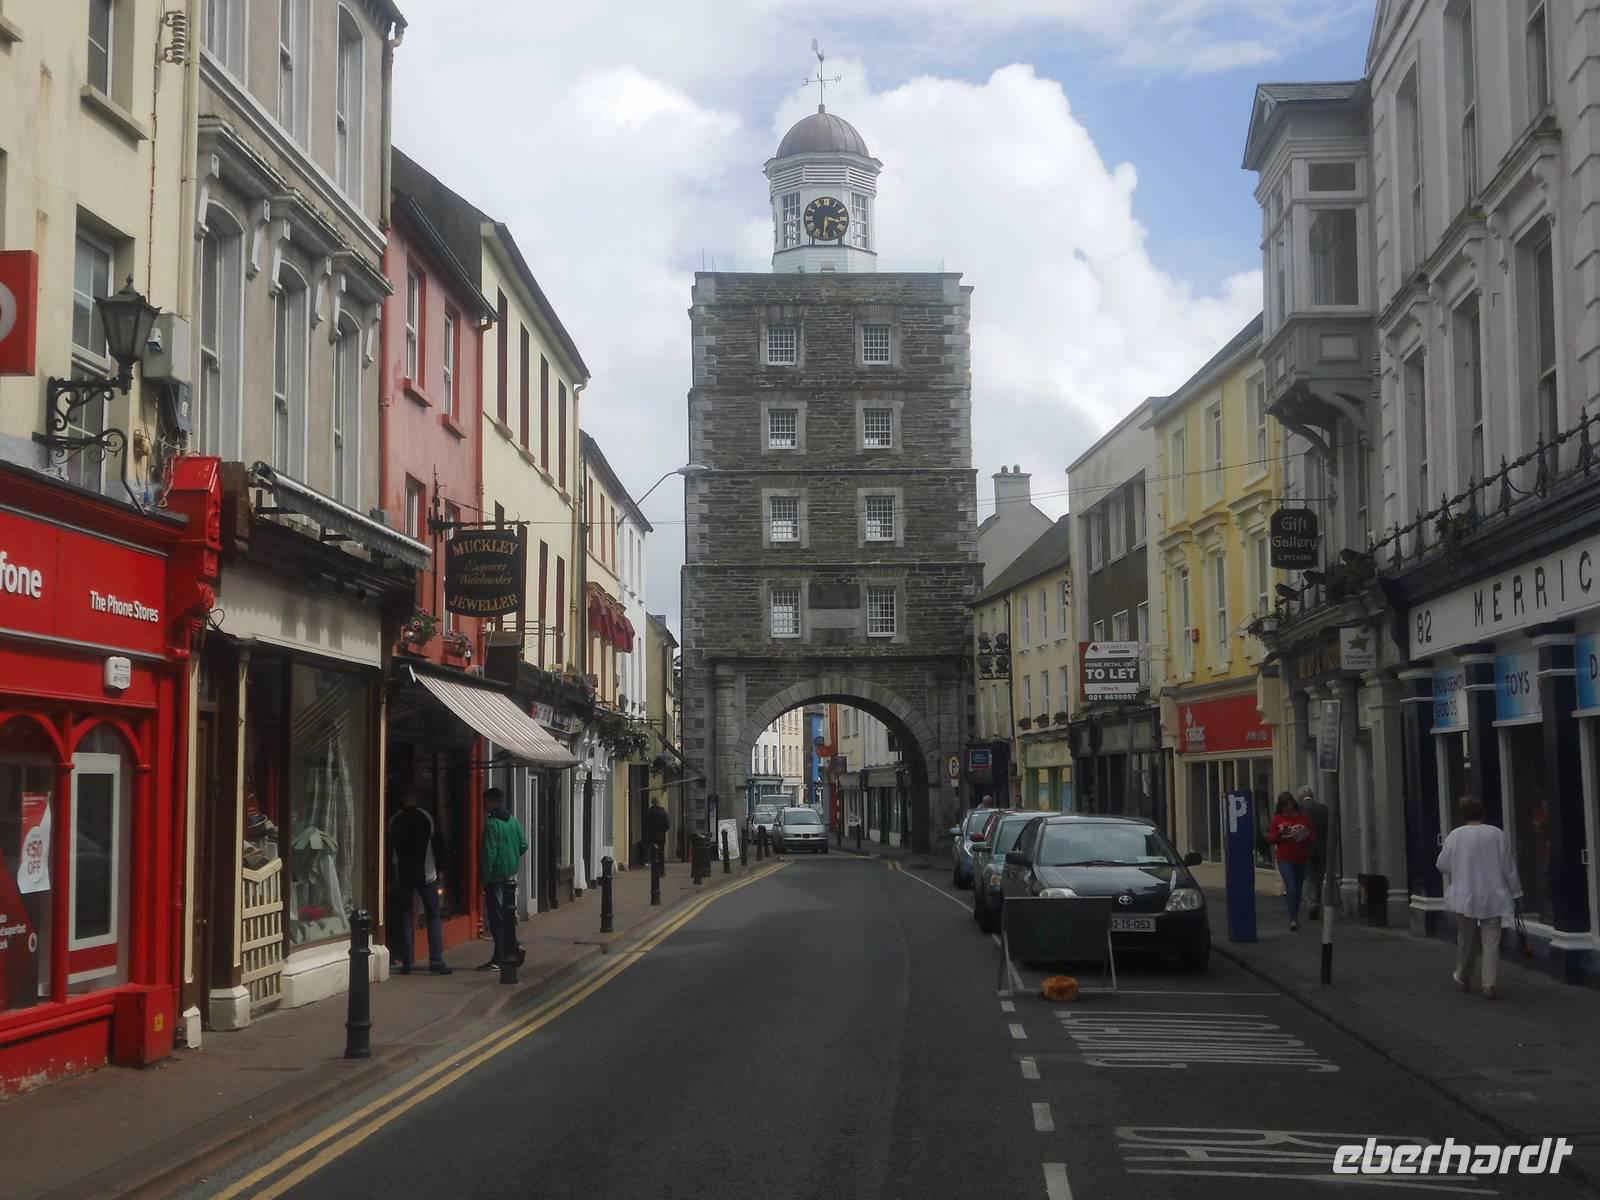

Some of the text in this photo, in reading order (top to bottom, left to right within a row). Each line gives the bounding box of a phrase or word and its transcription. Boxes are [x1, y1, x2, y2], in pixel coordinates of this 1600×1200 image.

[1282, 516, 1307, 534] Gift
[452, 539, 518, 557] MUCKLEY
[1272, 536, 1317, 551] Gallery
[0, 551, 42, 598] fone
[90, 590, 159, 623] The Phone Stores
[449, 594, 518, 611] JEWELLER
[1416, 610, 1432, 645] 82
[1085, 668, 1136, 680] TO LET
[1504, 671, 1530, 696] TOYS
[1228, 794, 1247, 832] P
